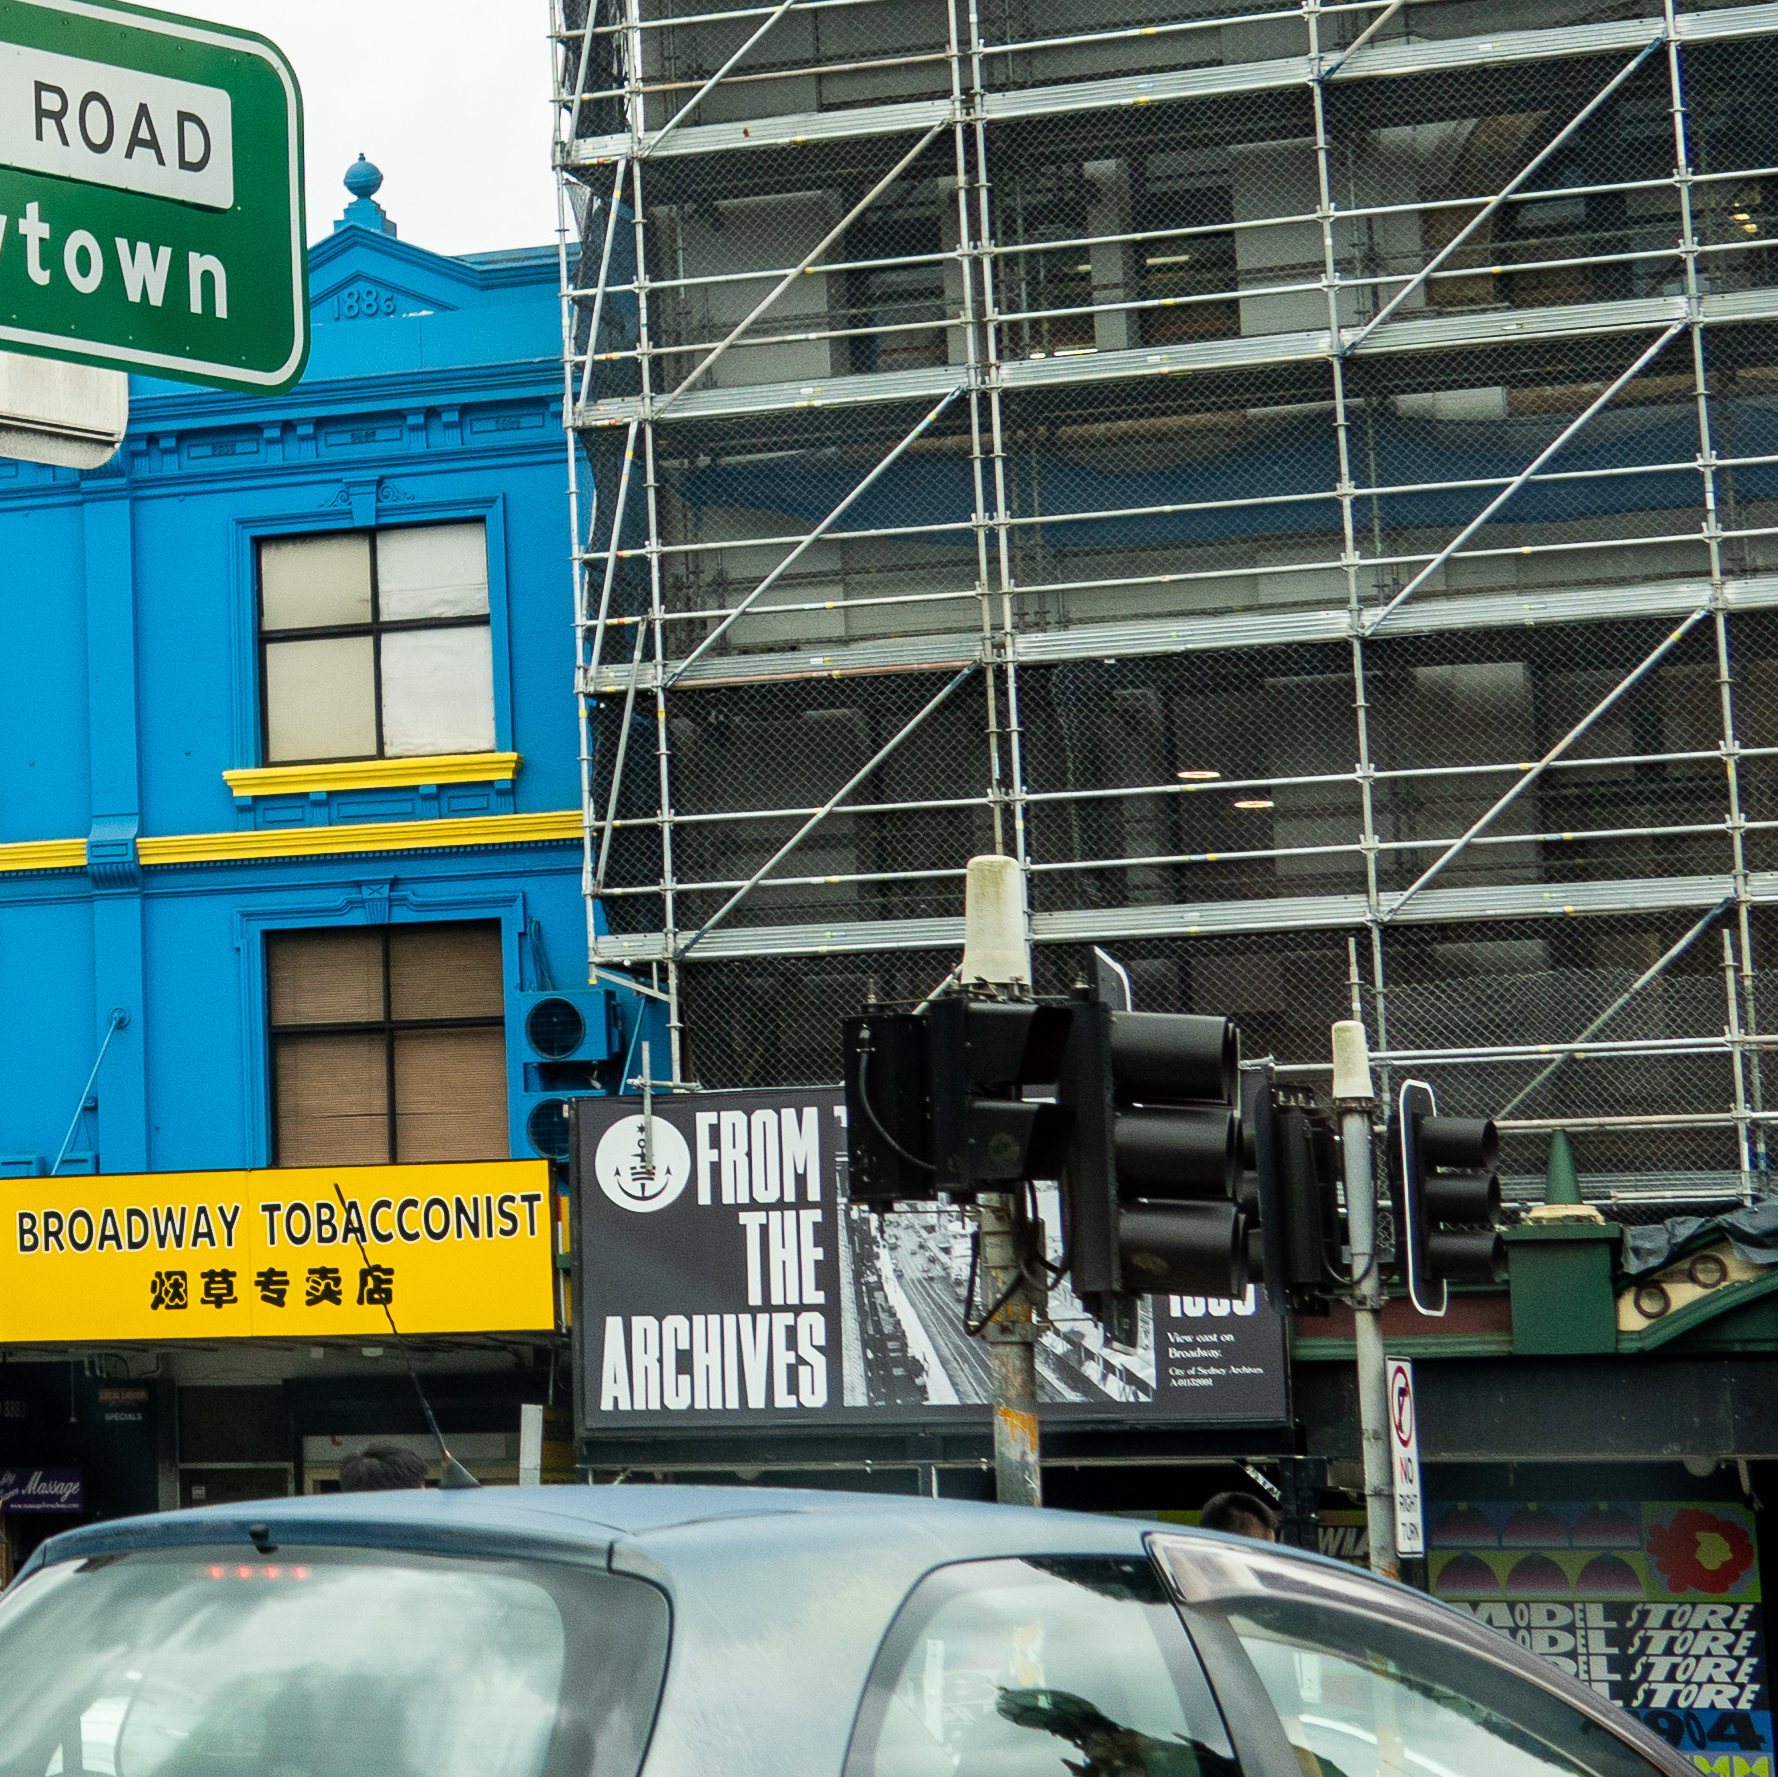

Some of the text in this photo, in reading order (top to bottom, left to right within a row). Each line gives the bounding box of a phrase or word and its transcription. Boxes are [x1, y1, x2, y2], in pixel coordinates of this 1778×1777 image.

[33, 83, 214, 175] ROAD
[333, 289, 396, 321] 1886
[694, 1106, 822, 1207] FROM
[16, 1191, 543, 1256] BROADWAY TOBACCONIST
[738, 1210, 826, 1307] THE
[149, 1262, 397, 1312] 烟草专卖店
[599, 1311, 829, 1413] ARCHIVES
[21, 1470, 81, 1503] Massage
[1399, 1456, 1414, 1486] NO
[1625, 1602, 1755, 1630] STORE
[1627, 1629, 1756, 1656] STORE
[1629, 1655, 1761, 1684] STORE
[1631, 1681, 1762, 1710] STORE
